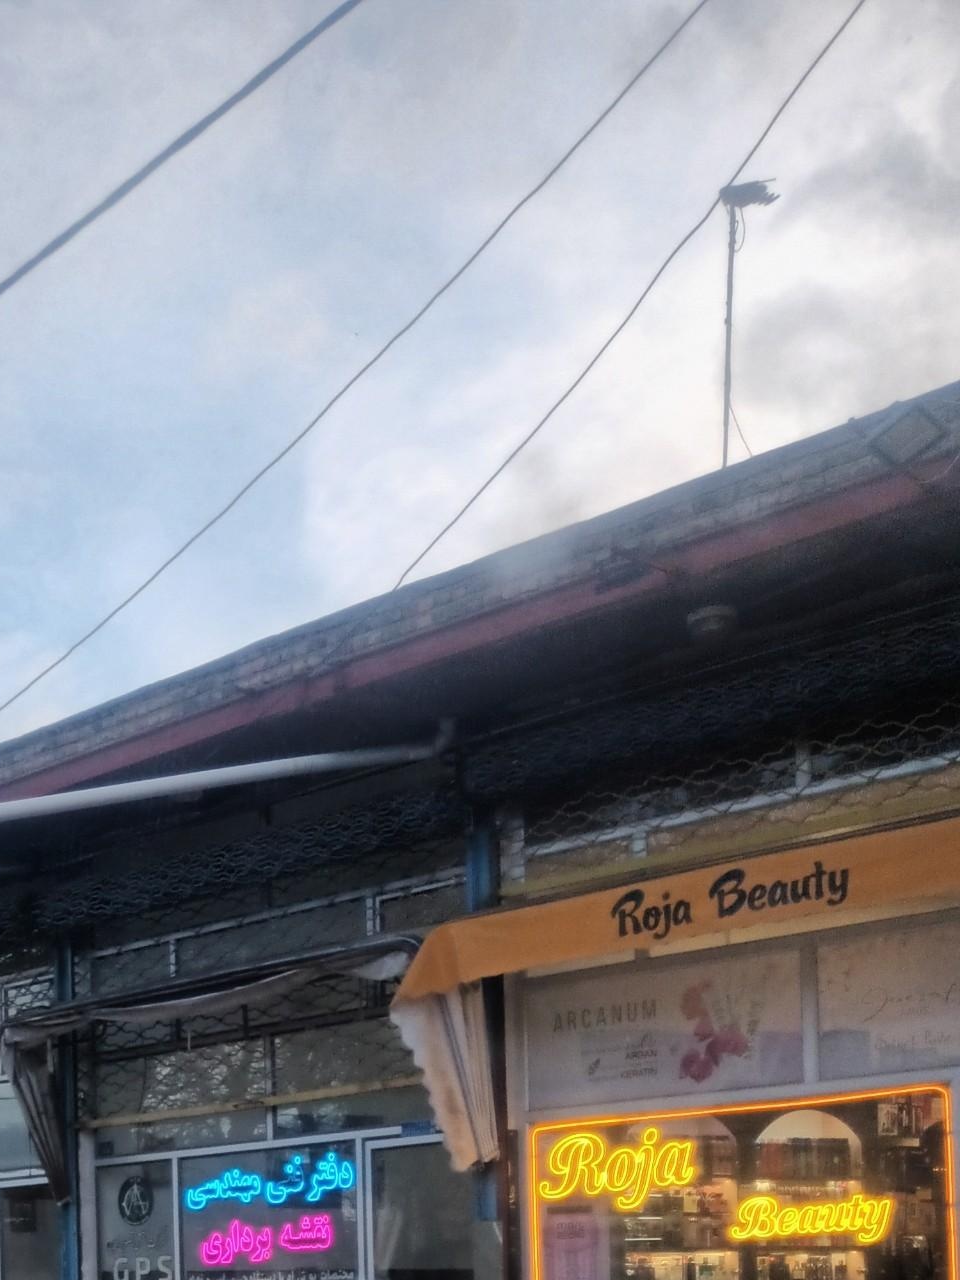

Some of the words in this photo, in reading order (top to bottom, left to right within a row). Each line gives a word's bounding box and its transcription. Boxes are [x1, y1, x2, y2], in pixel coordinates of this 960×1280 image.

[611, 888, 692, 940] Roja
[708, 860, 849, 918] Beauty
[553, 1000, 657, 1032] ARCANUM
[187, 1169, 261, 1209] مهندسی
[266, 1155, 305, 1204] فنی
[305, 1152, 354, 1201] دفتر
[539, 1127, 695, 1209] Roja
[731, 1194, 891, 1243] Beauty
[202, 1220, 272, 1264] برداری
[280, 1215, 331, 1249] نقشه
